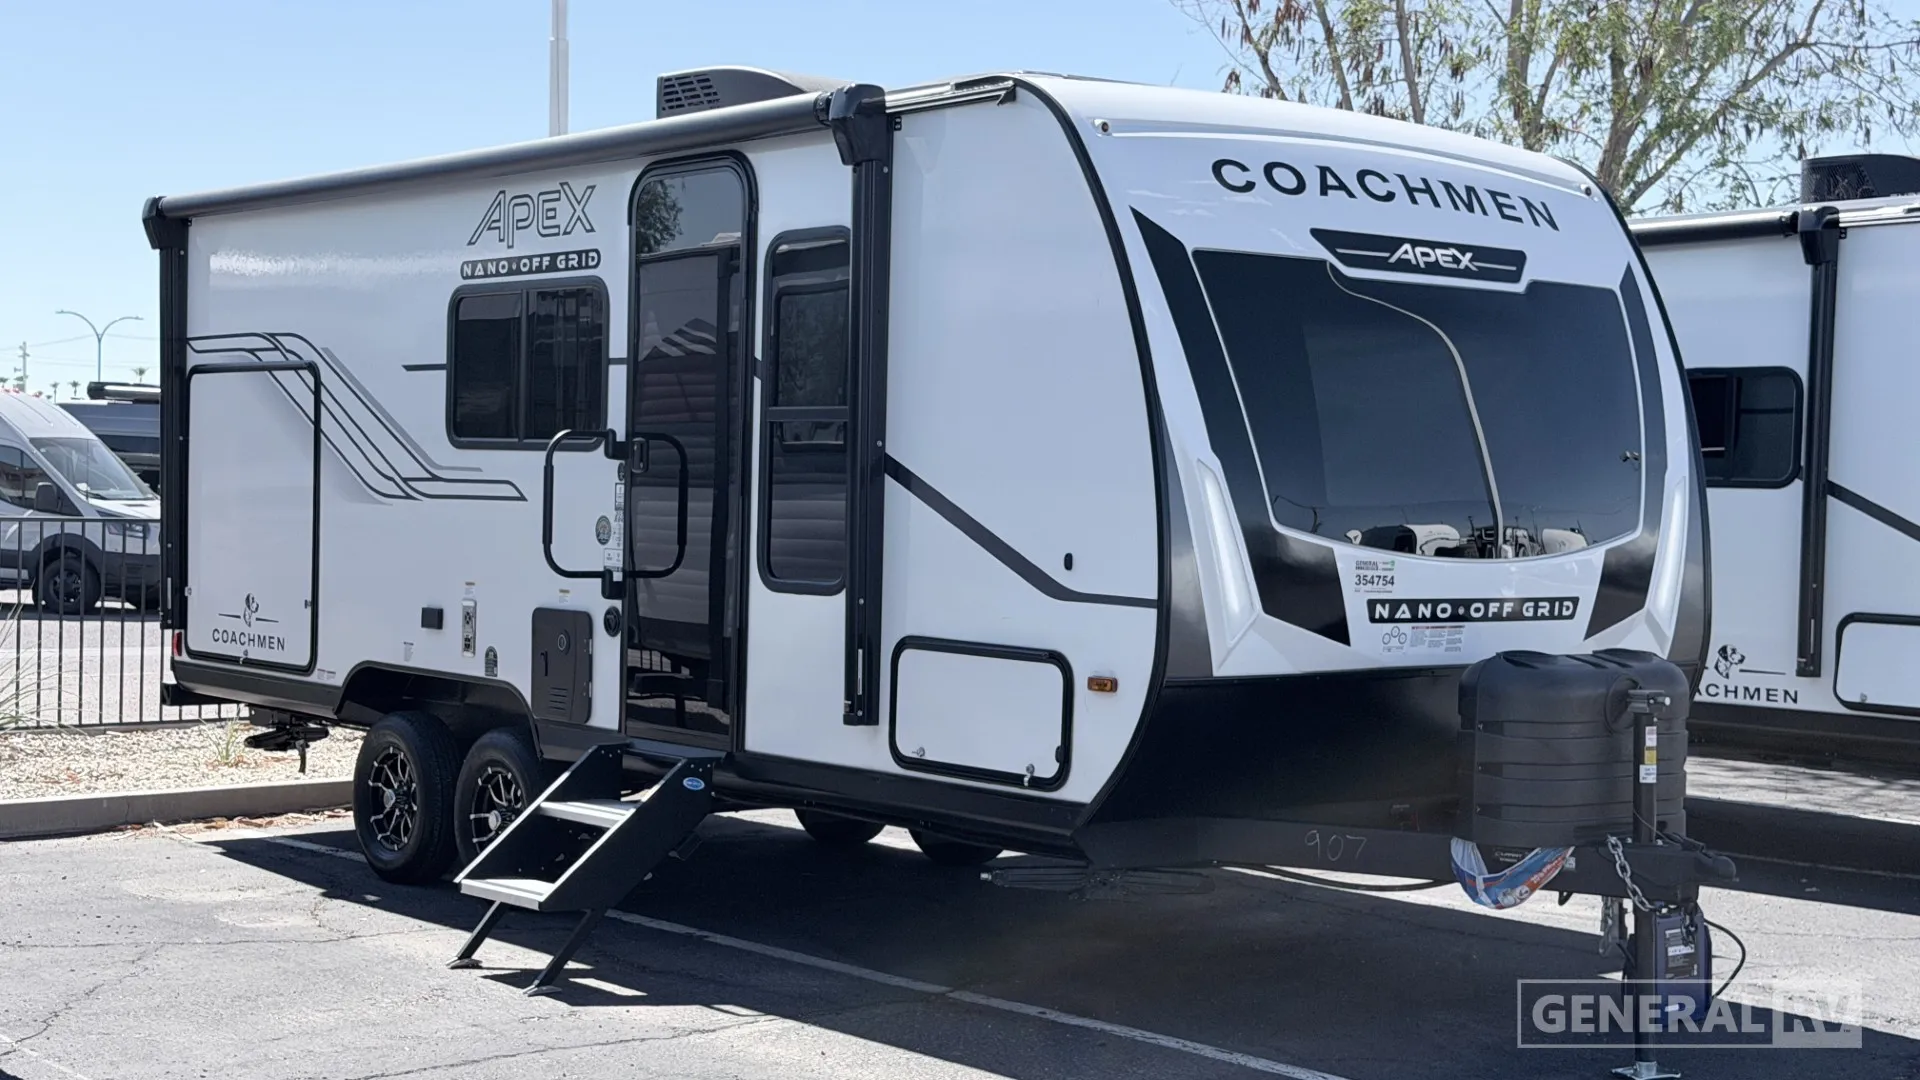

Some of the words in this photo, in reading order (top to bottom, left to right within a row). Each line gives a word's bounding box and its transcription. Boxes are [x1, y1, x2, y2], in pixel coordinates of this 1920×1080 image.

[1211, 158, 1560, 232] COACHMEN
[463, 260, 509, 277] NANO
[519, 256, 551, 272] OFF
[556, 251, 599, 269] GRID
[1355, 574, 1395, 587] 354754
[1374, 602, 1452, 619] NANO
[1469, 601, 1514, 618] OFF
[1522, 600, 1574, 617] GRID
[212, 628, 286, 651] COACHMEN
[1304, 829, 1368, 863] 907
